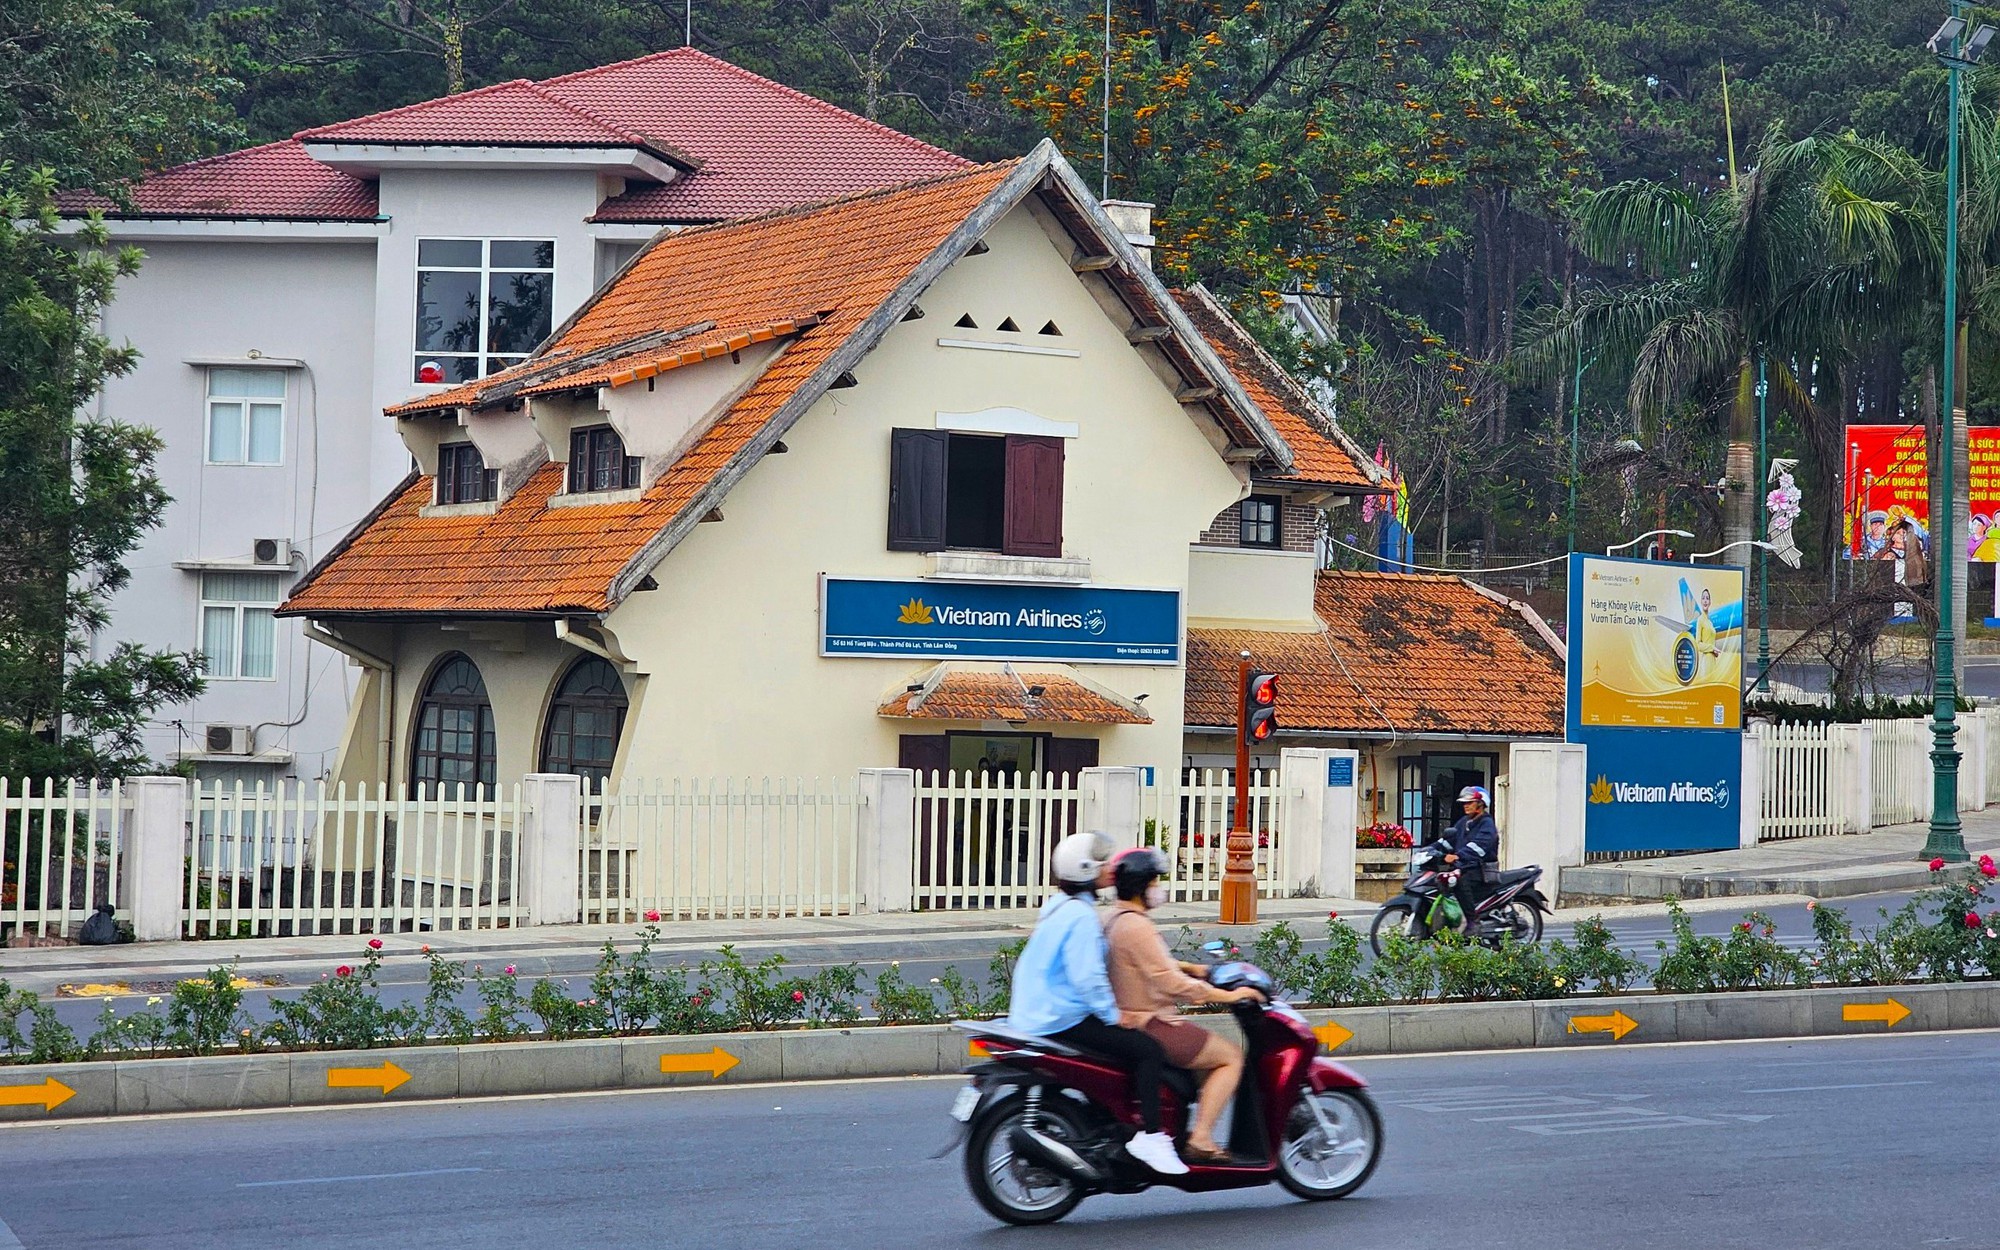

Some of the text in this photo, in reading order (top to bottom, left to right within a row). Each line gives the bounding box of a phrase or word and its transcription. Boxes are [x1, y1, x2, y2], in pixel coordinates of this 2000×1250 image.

[1976, 438, 1995, 449] SỨC
[1970, 466, 1988, 476] ẠNH
[1970, 476, 1989, 488] ỮNG
[1894, 489, 1914, 501] VIỆT
[1915, 491, 1929, 500] NA
[1590, 598, 1658, 614] Hàng Không Việt Nam
[935, 605, 1083, 629] Vietnam Airlines
[1624, 614, 1637, 625] Cao
[1637, 615, 1650, 626] Mới
[1614, 782, 1667, 803] Vietnam
[1669, 781, 1714, 803] Airlines
